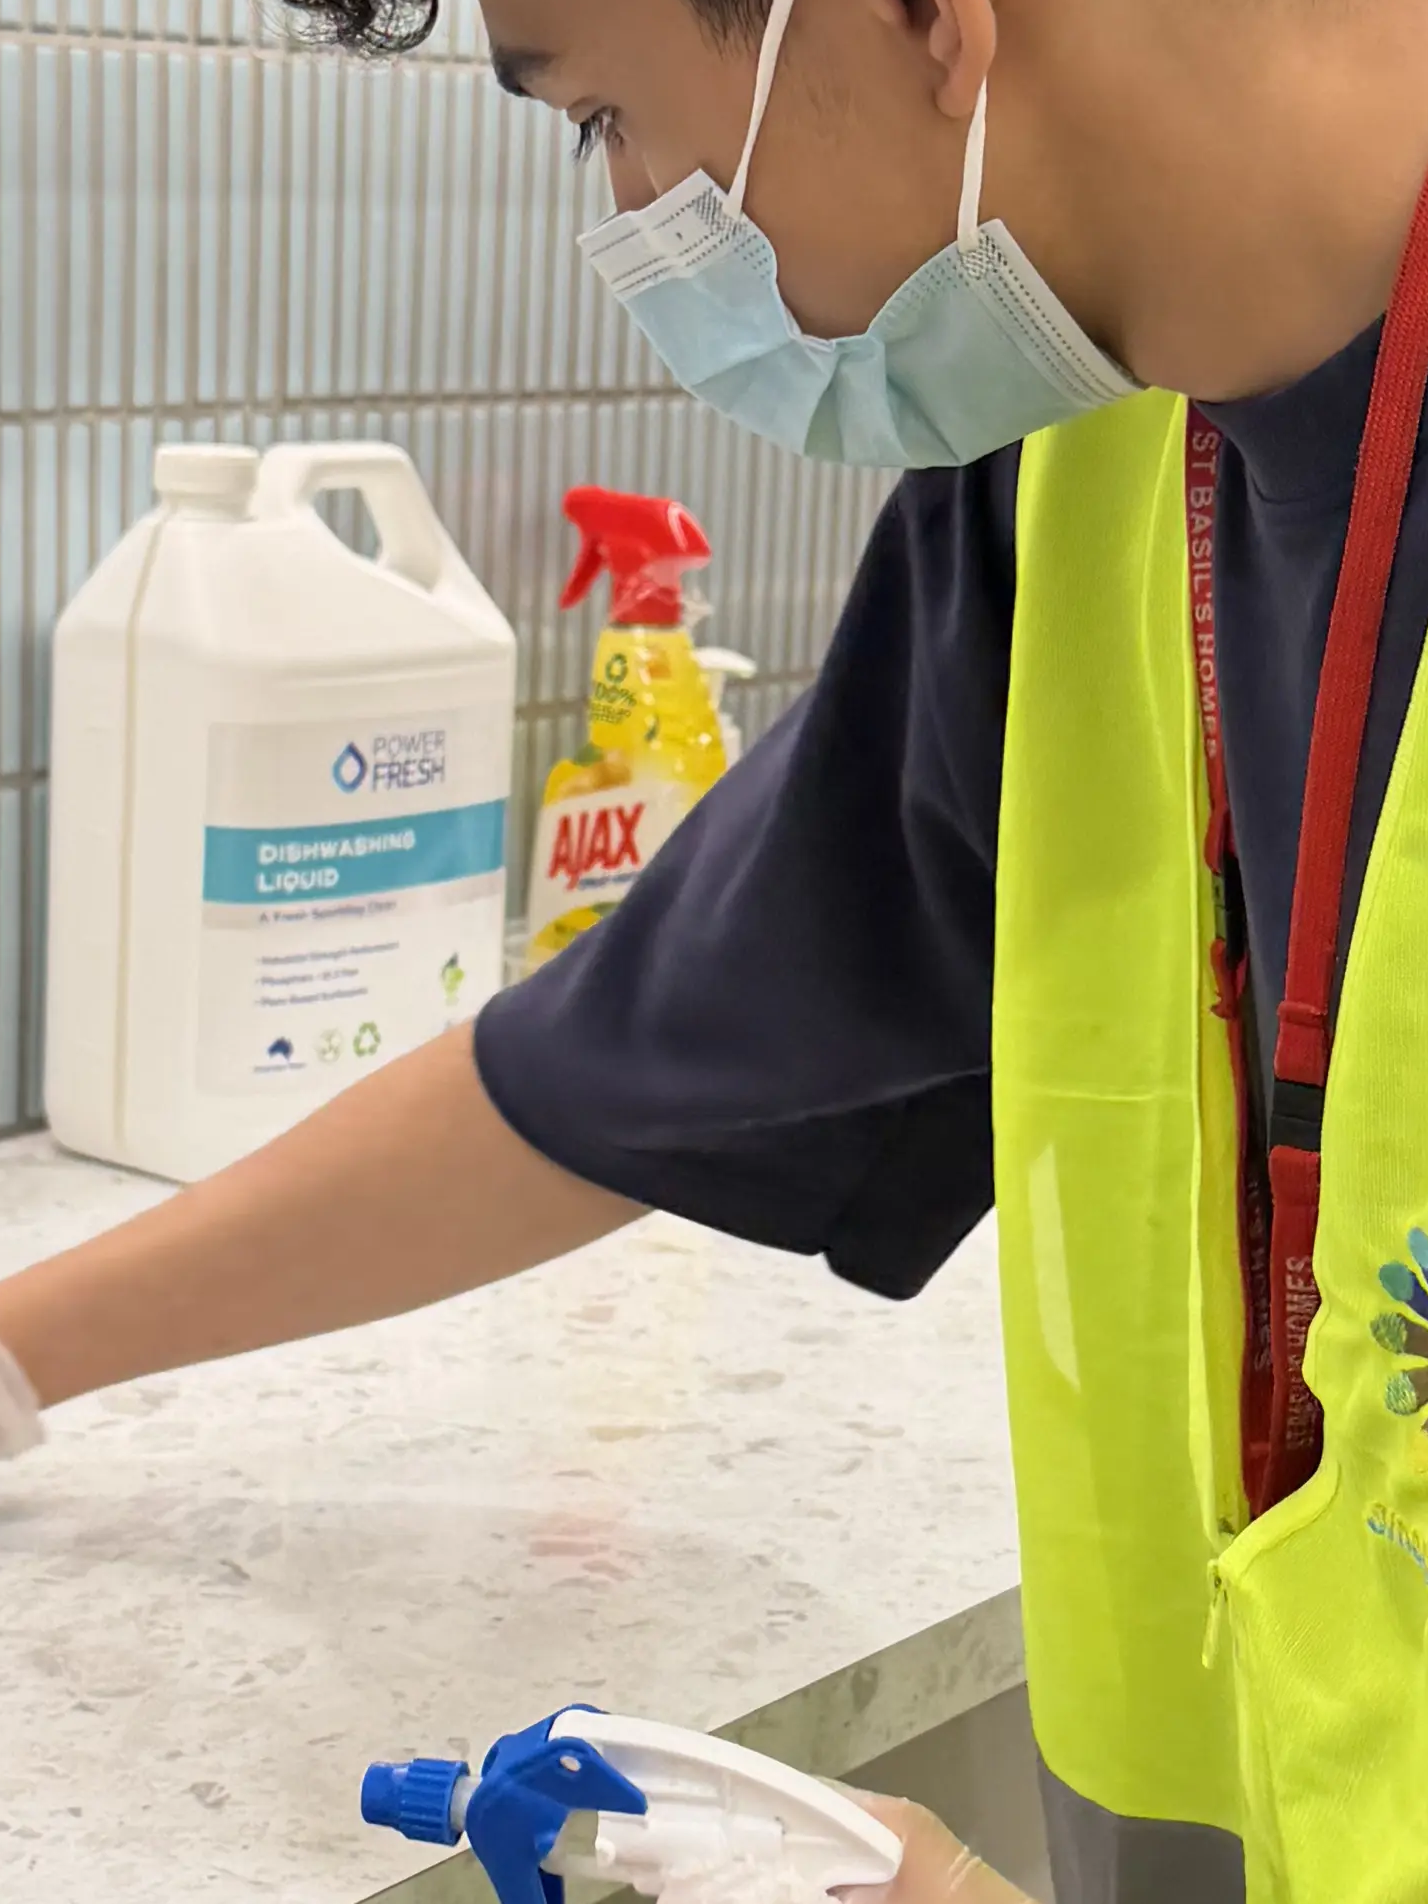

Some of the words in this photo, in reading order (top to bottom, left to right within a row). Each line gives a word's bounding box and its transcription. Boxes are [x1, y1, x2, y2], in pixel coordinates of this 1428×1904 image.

[1191, 430, 1219, 475] ST
[1190, 486, 1214, 624] BASIL'S
[373, 729, 445, 757] POWER
[372, 755, 446, 792] FRESH
[258, 829, 416, 865] DISHWASHING
[547, 801, 644, 892] AJAX
[257, 867, 340, 894] LIQUID
